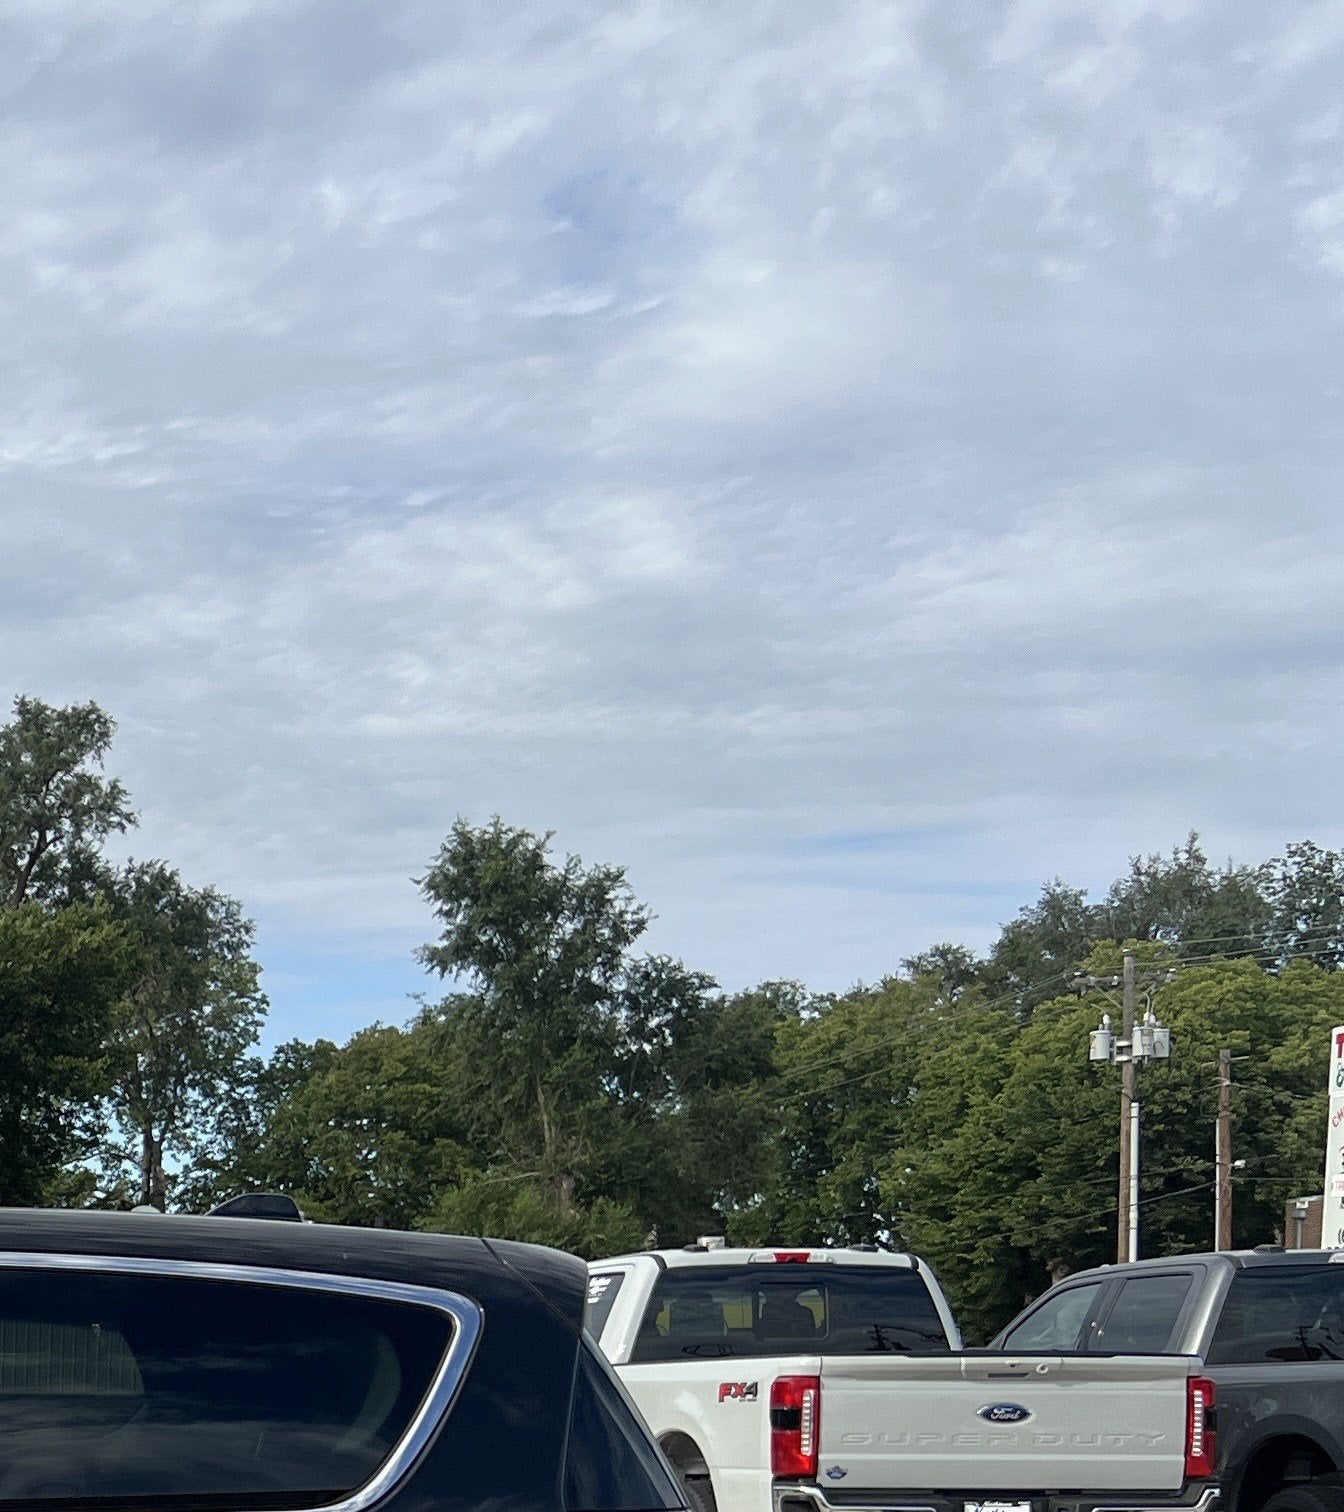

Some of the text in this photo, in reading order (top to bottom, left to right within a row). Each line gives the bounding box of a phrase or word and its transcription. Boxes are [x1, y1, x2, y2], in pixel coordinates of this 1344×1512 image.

[719, 1382, 758, 1402] FX4
[991, 1407, 1021, 1420] Ford
[841, 1432, 1166, 1446] SUPER DUTY
